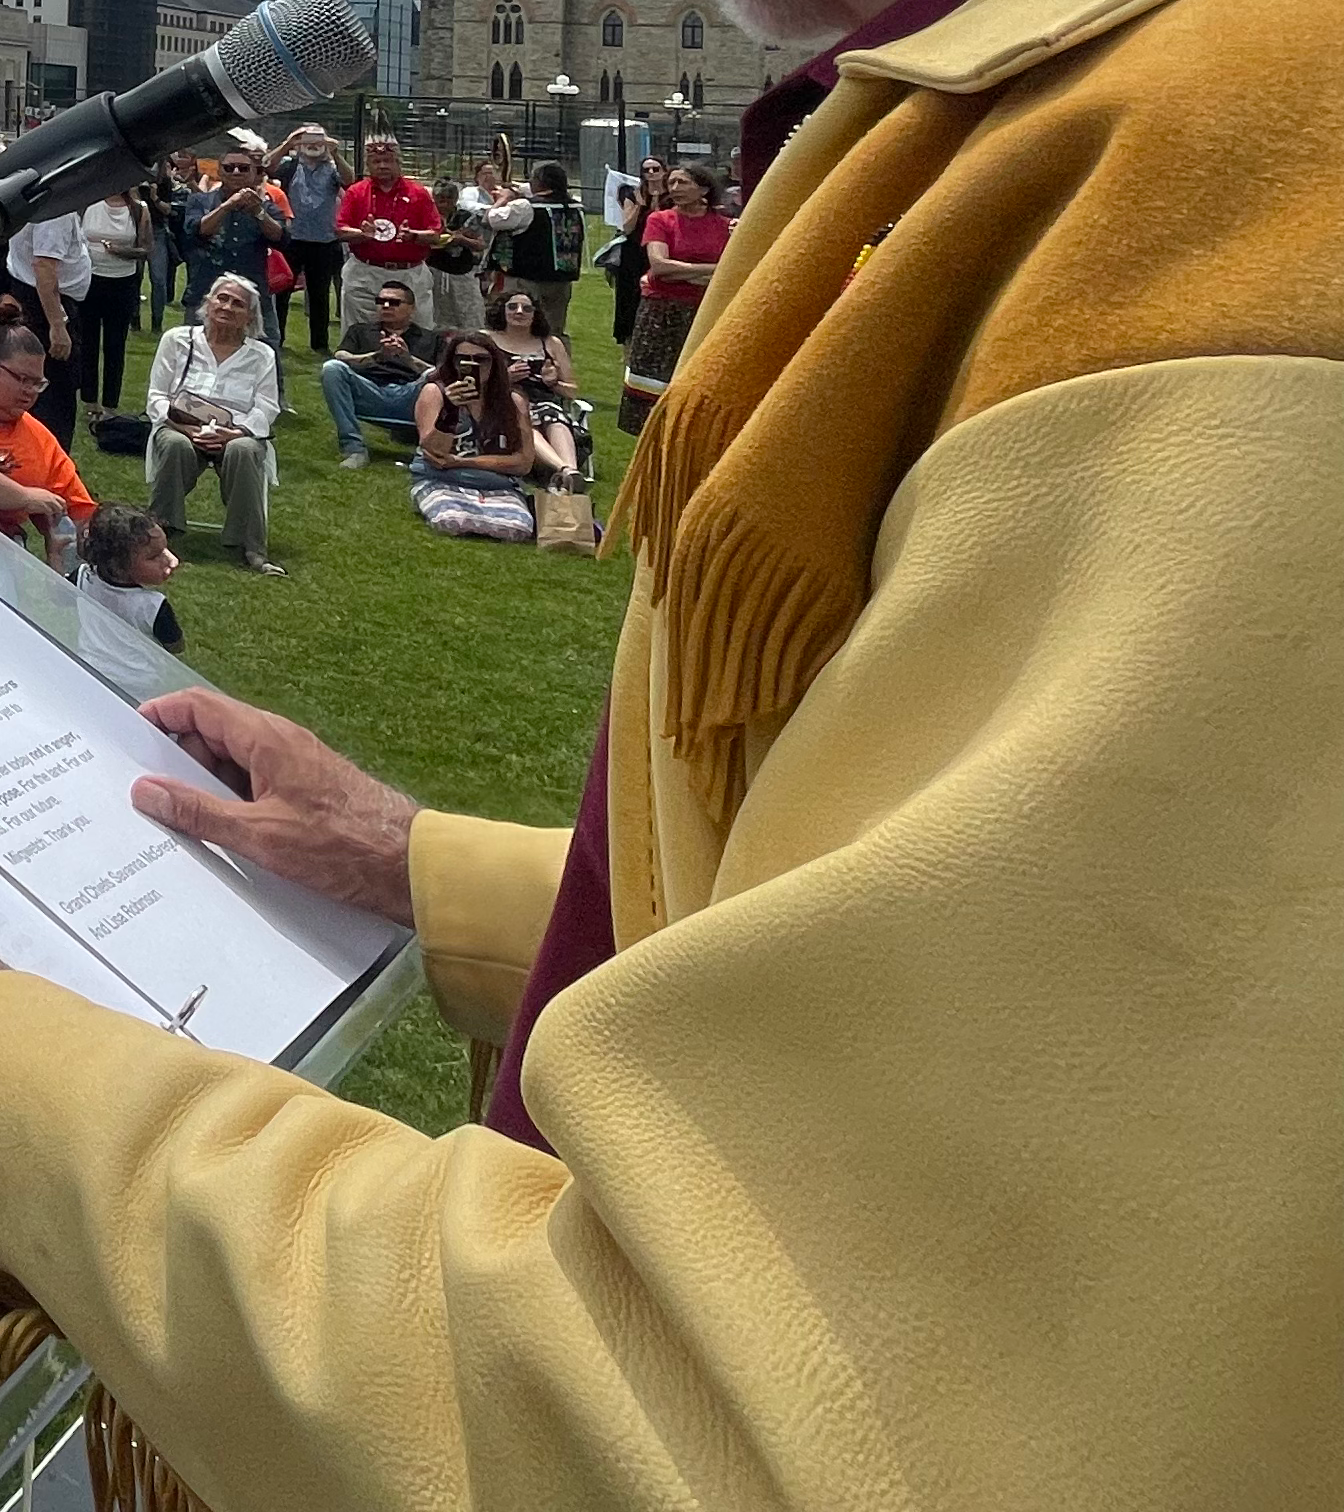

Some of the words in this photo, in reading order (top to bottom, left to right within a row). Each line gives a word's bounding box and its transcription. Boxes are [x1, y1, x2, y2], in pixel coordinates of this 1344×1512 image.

[58, 889, 92, 916] Grand
[87, 919, 113, 942] And
[102, 911, 130, 931] Lisa
